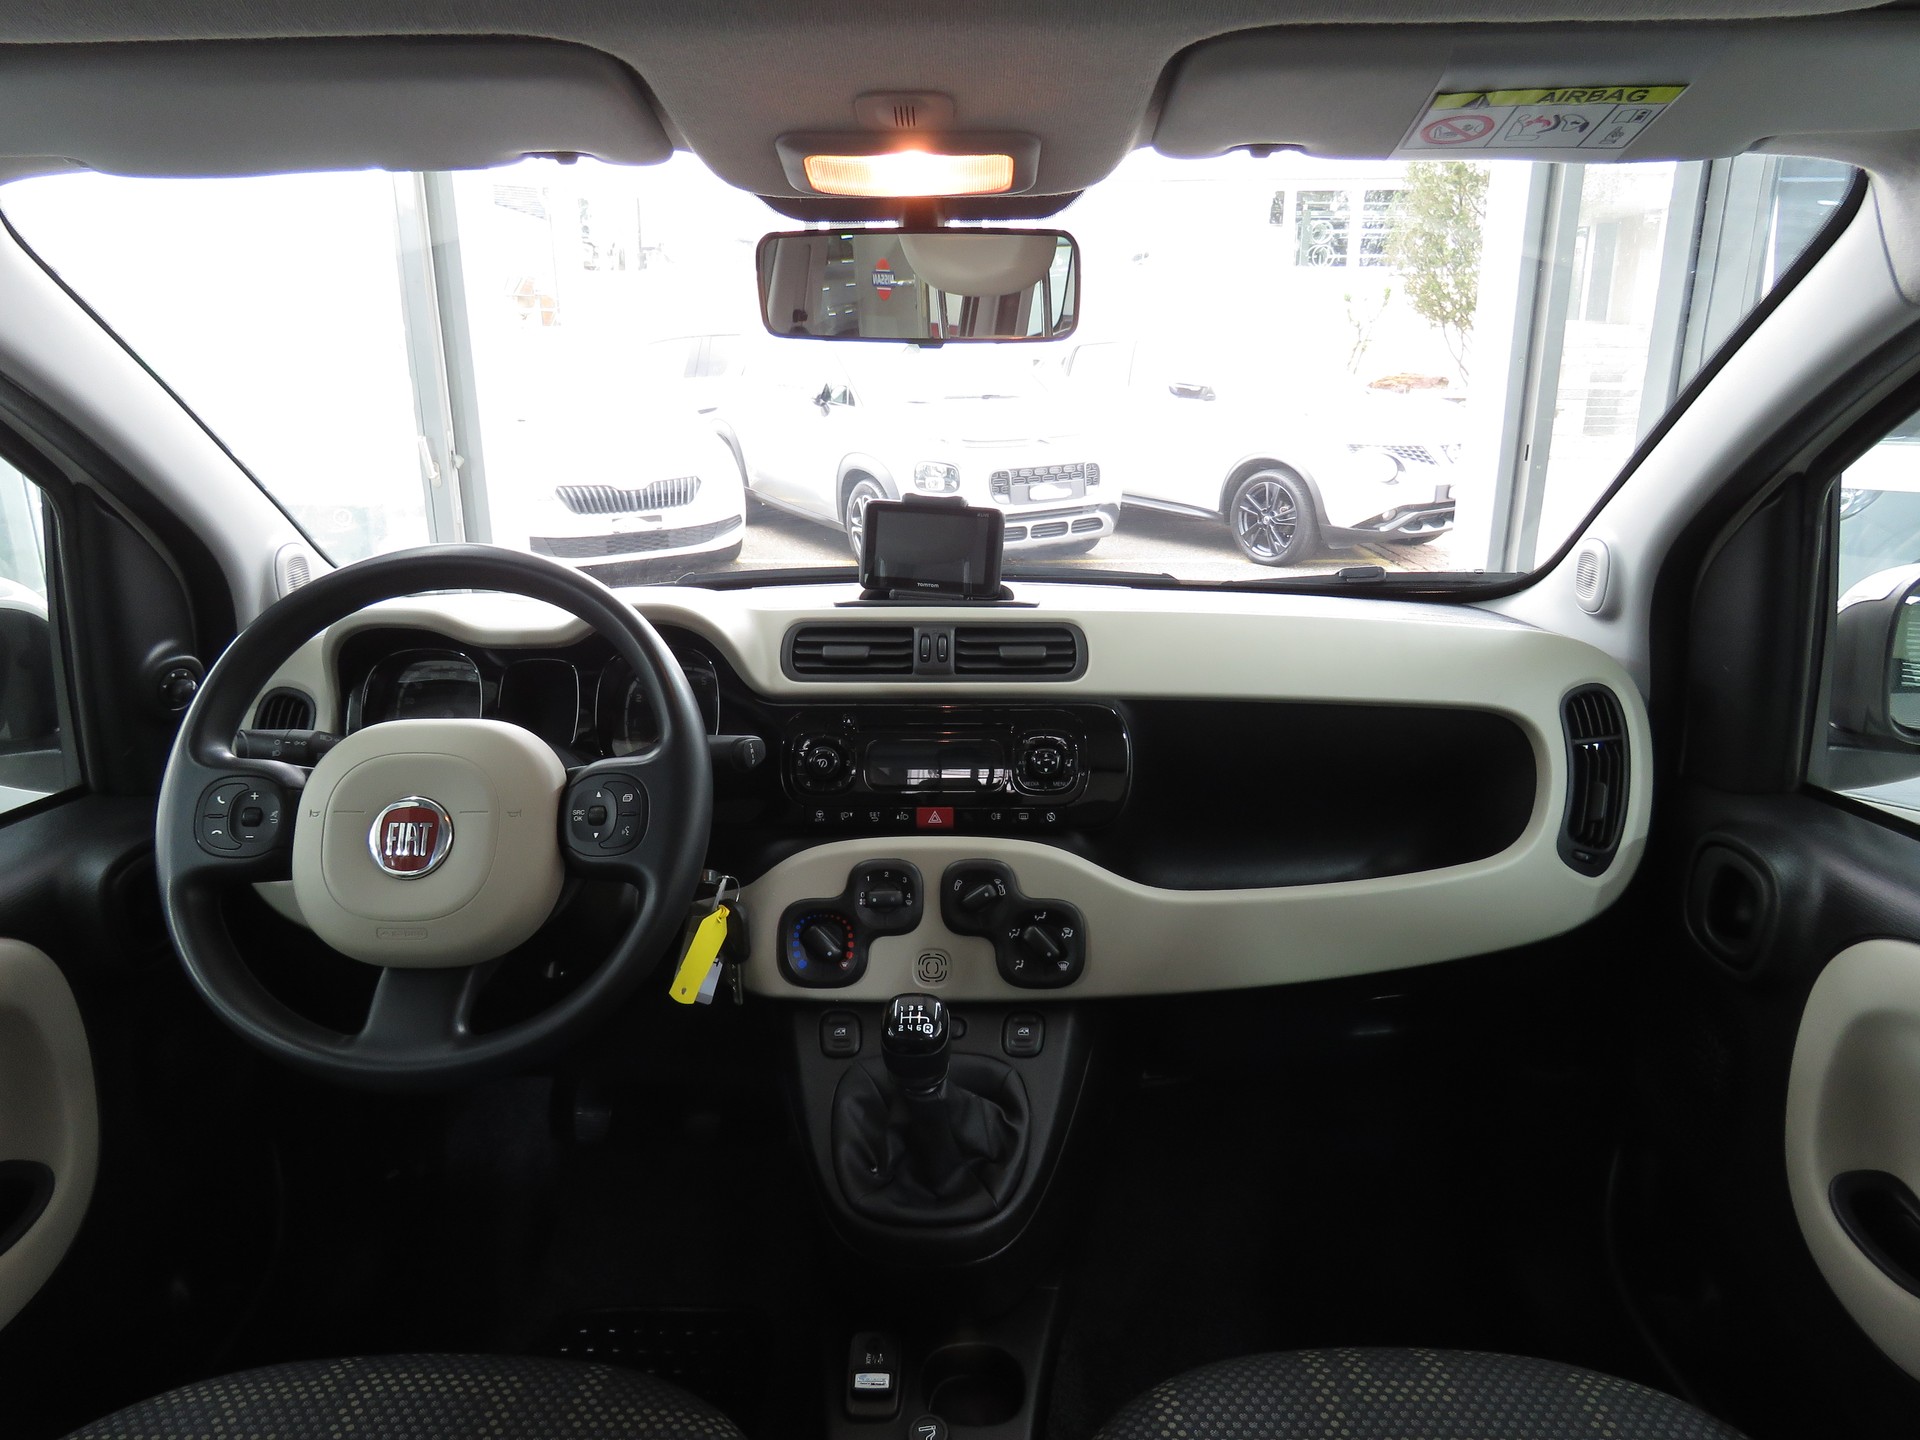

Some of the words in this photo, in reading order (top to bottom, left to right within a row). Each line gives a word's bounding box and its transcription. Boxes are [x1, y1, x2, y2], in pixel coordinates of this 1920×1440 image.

[1537, 89, 1649, 104] AIRBAG
[385, 822, 433, 857] FIAT
[898, 1024, 904, 1032] 2
[907, 1024, 913, 1032] 4
[916, 1024, 922, 1032] 6
